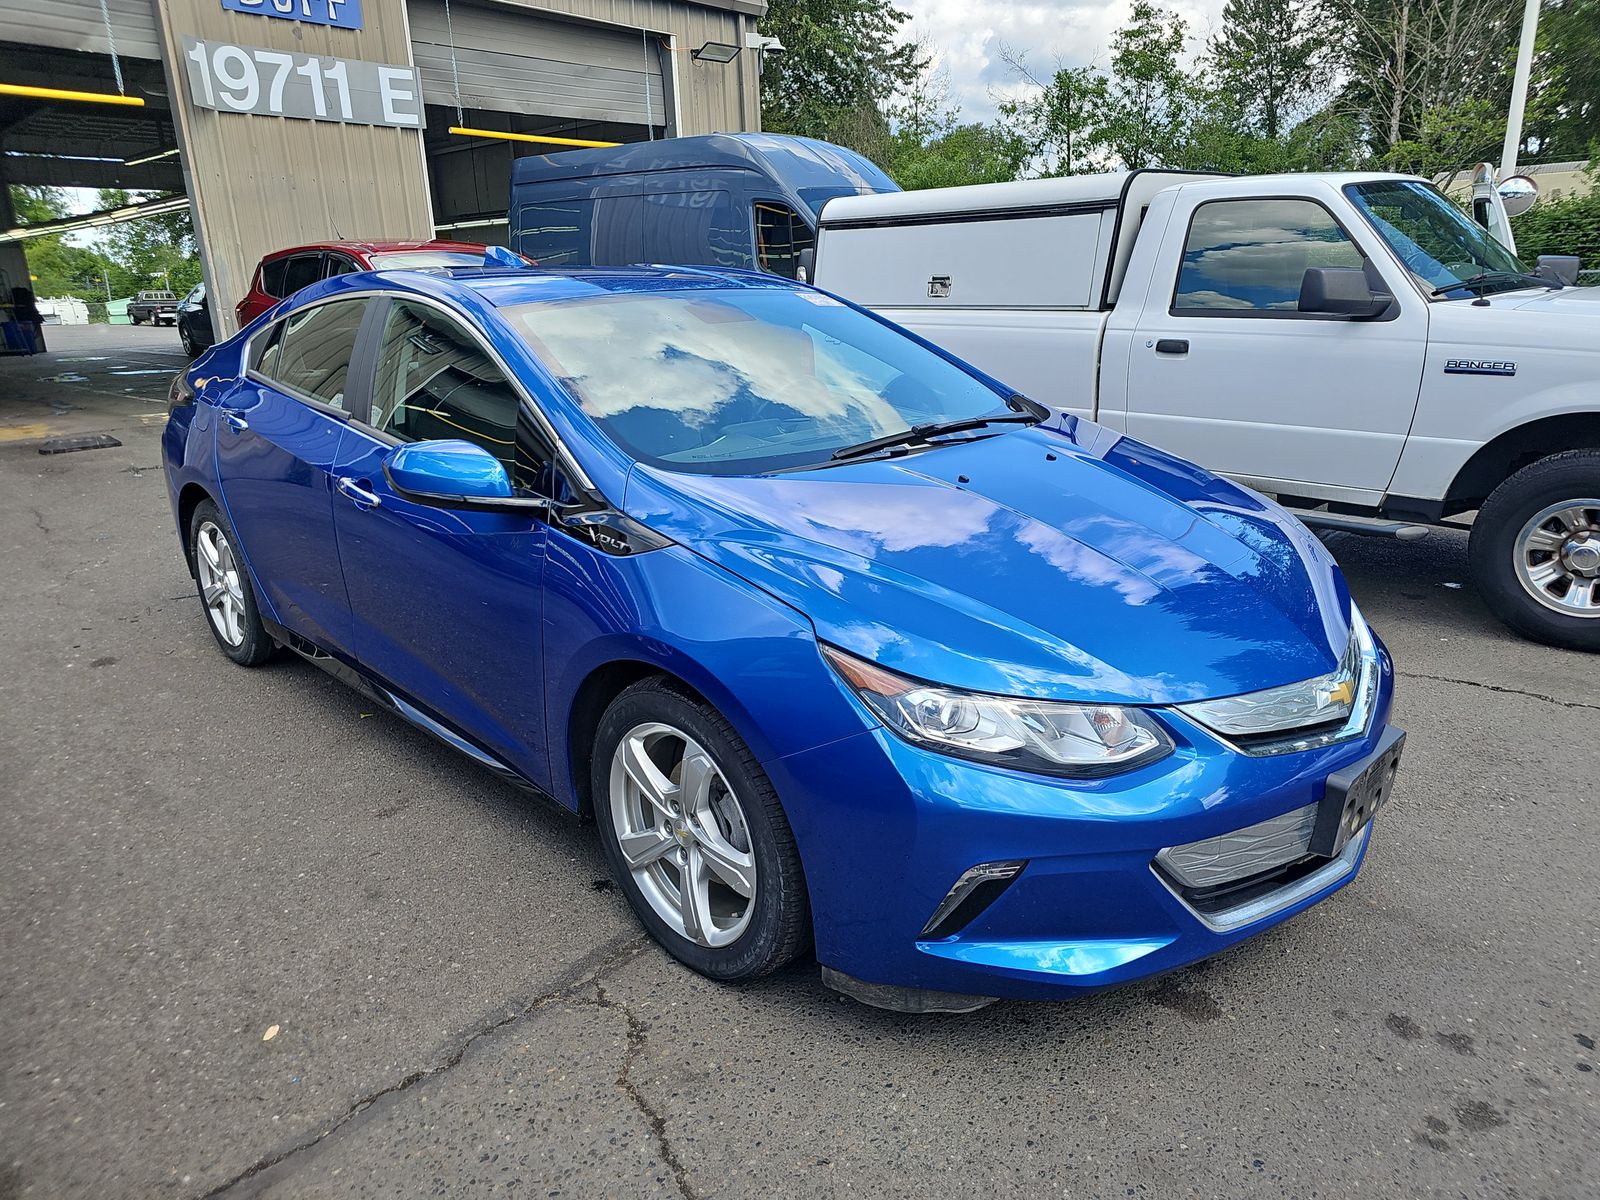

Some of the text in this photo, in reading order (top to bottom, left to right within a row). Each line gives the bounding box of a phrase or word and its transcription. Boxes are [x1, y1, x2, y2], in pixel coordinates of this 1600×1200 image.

[188, 42, 419, 125] 19711 E
[1445, 360, 1517, 371] RANGER
[588, 526, 631, 550] VOLT
